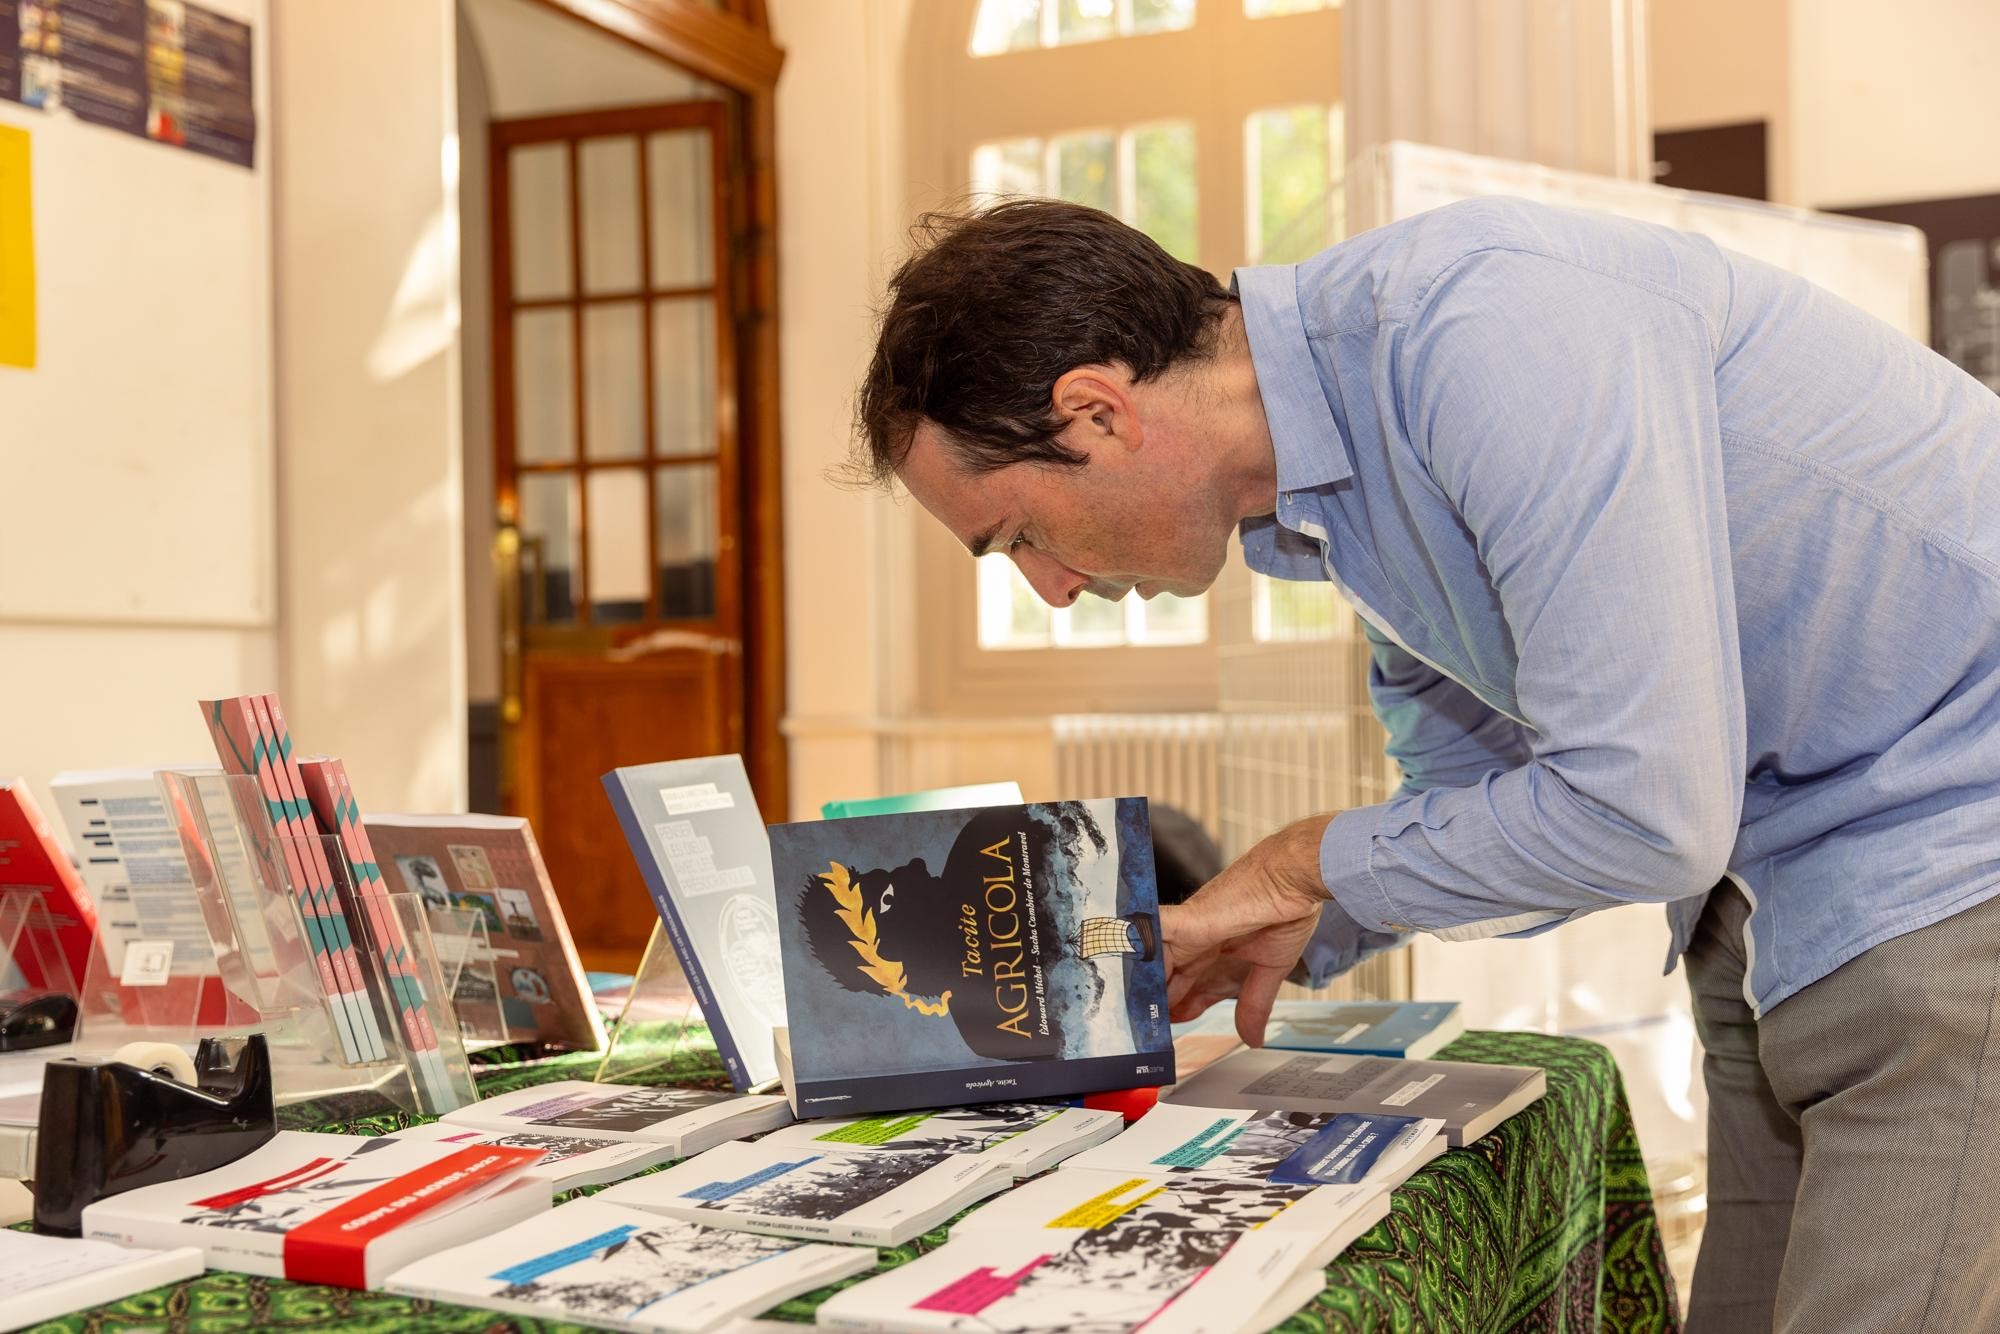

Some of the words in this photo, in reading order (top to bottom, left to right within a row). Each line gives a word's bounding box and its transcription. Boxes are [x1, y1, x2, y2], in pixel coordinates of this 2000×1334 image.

[1018, 832, 1031, 877] Montravel
[1023, 878, 1032, 889] de
[1026, 889, 1036, 927] Cambier
[958, 904, 983, 977] Tacite
[980, 835, 1032, 1039] AGRICOLA
[1029, 929, 1040, 955] Sacha
[1033, 965, 1044, 995] Michel
[1036, 997, 1049, 1035] Édouard
[965, 1080, 995, 1090] Agricola
[995, 1079, 1018, 1087] Tacite,
[341, 1204, 397, 1231] COUPE
[395, 1194, 418, 1209] DU
[412, 1169, 469, 1198] MONDE
[466, 1155, 502, 1173] 2022
